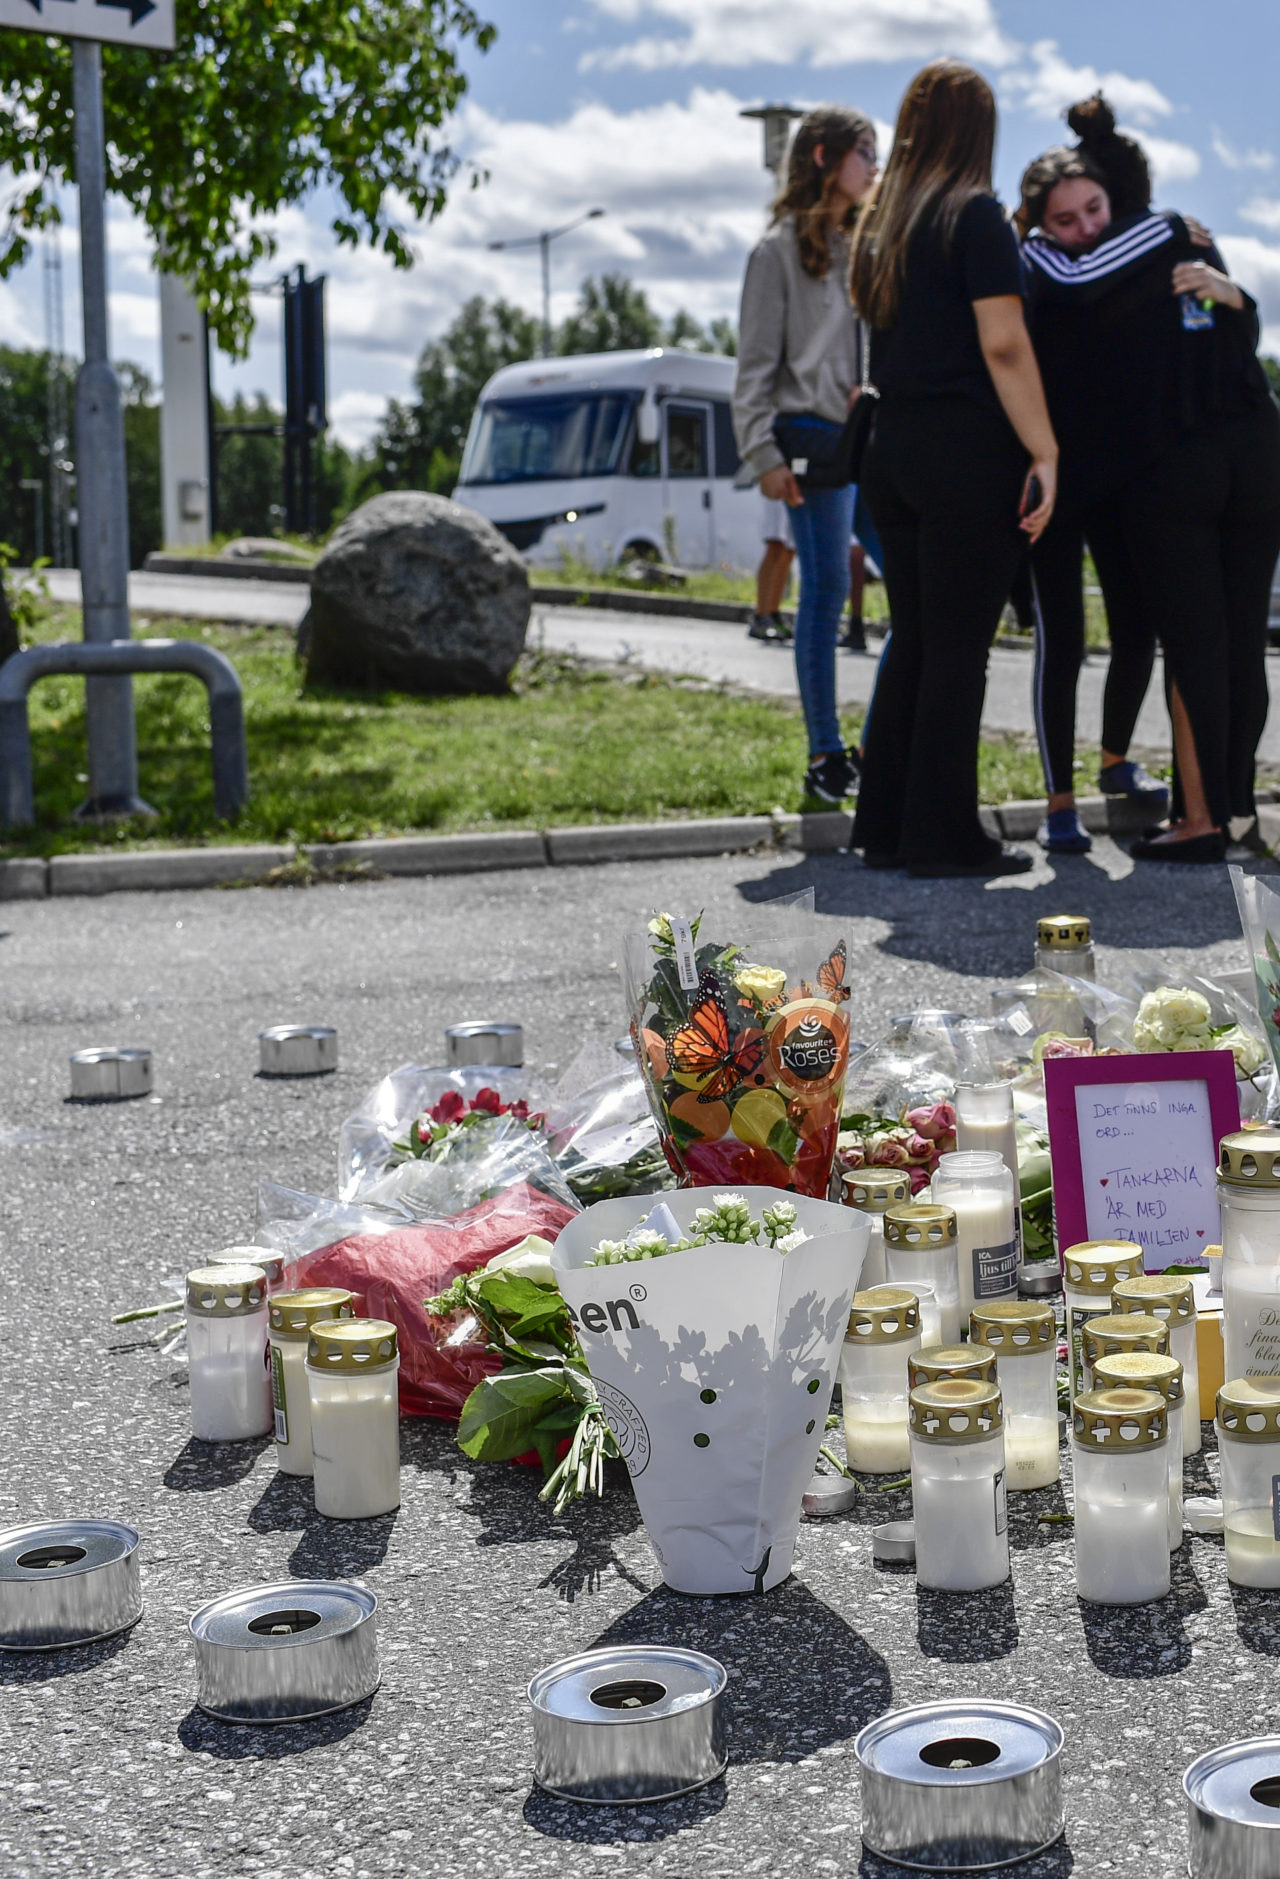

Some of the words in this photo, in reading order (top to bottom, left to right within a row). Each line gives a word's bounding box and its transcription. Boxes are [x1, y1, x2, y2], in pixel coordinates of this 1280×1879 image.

[792, 1039, 829, 1050] favourite
[776, 1046, 842, 1069] Roses
[1093, 1103, 1120, 1119] DET
[1125, 1102, 1157, 1115] FINNS
[1168, 1102, 1197, 1115] INGA
[1106, 1166, 1203, 1189] TANKARNA
[1105, 1195, 1131, 1220] ÄR
[1137, 1200, 1167, 1220] MED
[1114, 1227, 1190, 1247] FAMILJEN
[979, 1252, 991, 1260] ICA
[980, 1263, 1000, 1277] ljus
[610, 1391, 648, 1454] CRAFTED
